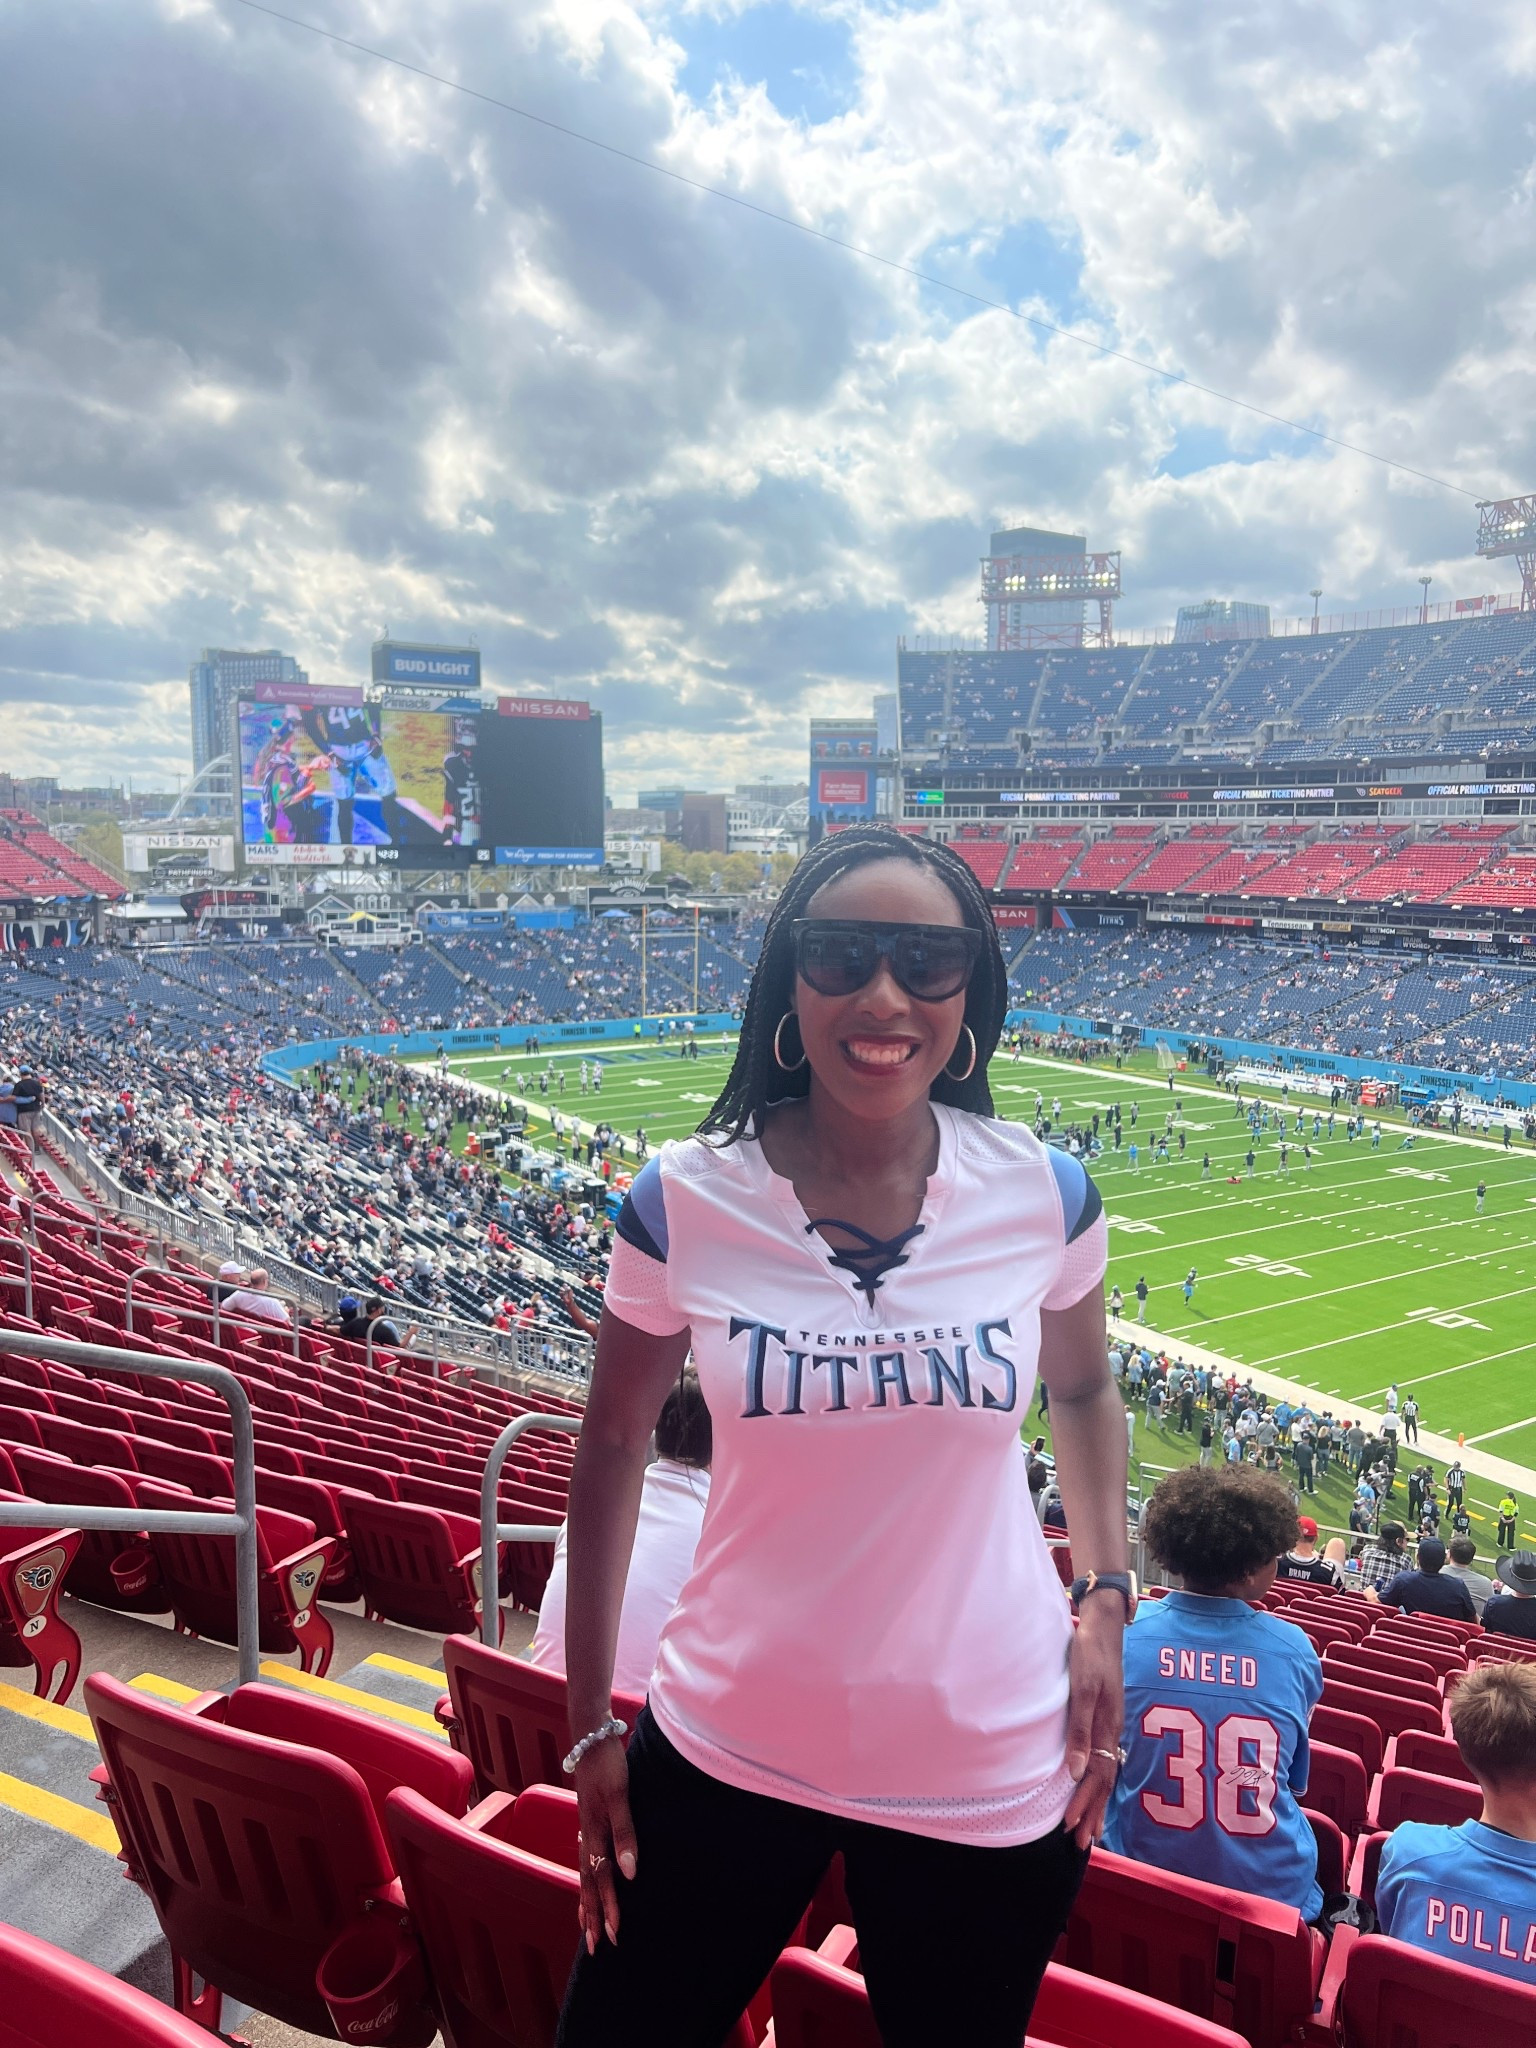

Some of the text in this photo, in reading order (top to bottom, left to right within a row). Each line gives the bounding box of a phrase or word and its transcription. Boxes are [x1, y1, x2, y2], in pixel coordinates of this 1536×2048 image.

[394, 658, 472, 676] BUD LIGHT
[382, 695, 432, 710] Pinnacle
[510, 702, 579, 716] NISSAN
[1213, 788, 1334, 800] OFFICIAL PRIMARY TICKETING PARTNER
[1368, 787, 1403, 796] SEATGEEK
[1427, 783, 1535, 796] OFFICIAL PRIMARY TICKETING
[1024, 792, 1053, 801] PRIMARY
[1054, 792, 1089, 801] TICKETING
[1090, 792, 1120, 800] PARTNER
[148, 837, 221, 847] NISSAN
[247, 846, 279, 855] MARS
[1098, 913, 1125, 926] TITANS
[1369, 927, 1396, 935] BETMGM
[1508, 934, 1531, 945] FedEx
[561, 1028, 588, 1037] TENNESSEE
[452, 1035, 481, 1044] TENNESSEE
[1318, 1059, 1336, 1070] TOUGH
[1420, 1074, 1452, 1088] TENNESSEE
[1224, 1254, 1297, 1277] 20
[1404, 1306, 1480, 1329] 10
[800, 1326, 963, 1347] TENNESSEE
[729, 1316, 1017, 1418] TITANS
[1288, 1567, 1312, 1581] BRADY
[297, 1613, 308, 1625] M
[29, 1620, 40, 1633] N
[1158, 1646, 1258, 1688] SNEED
[1139, 1703, 1281, 1838] 38
